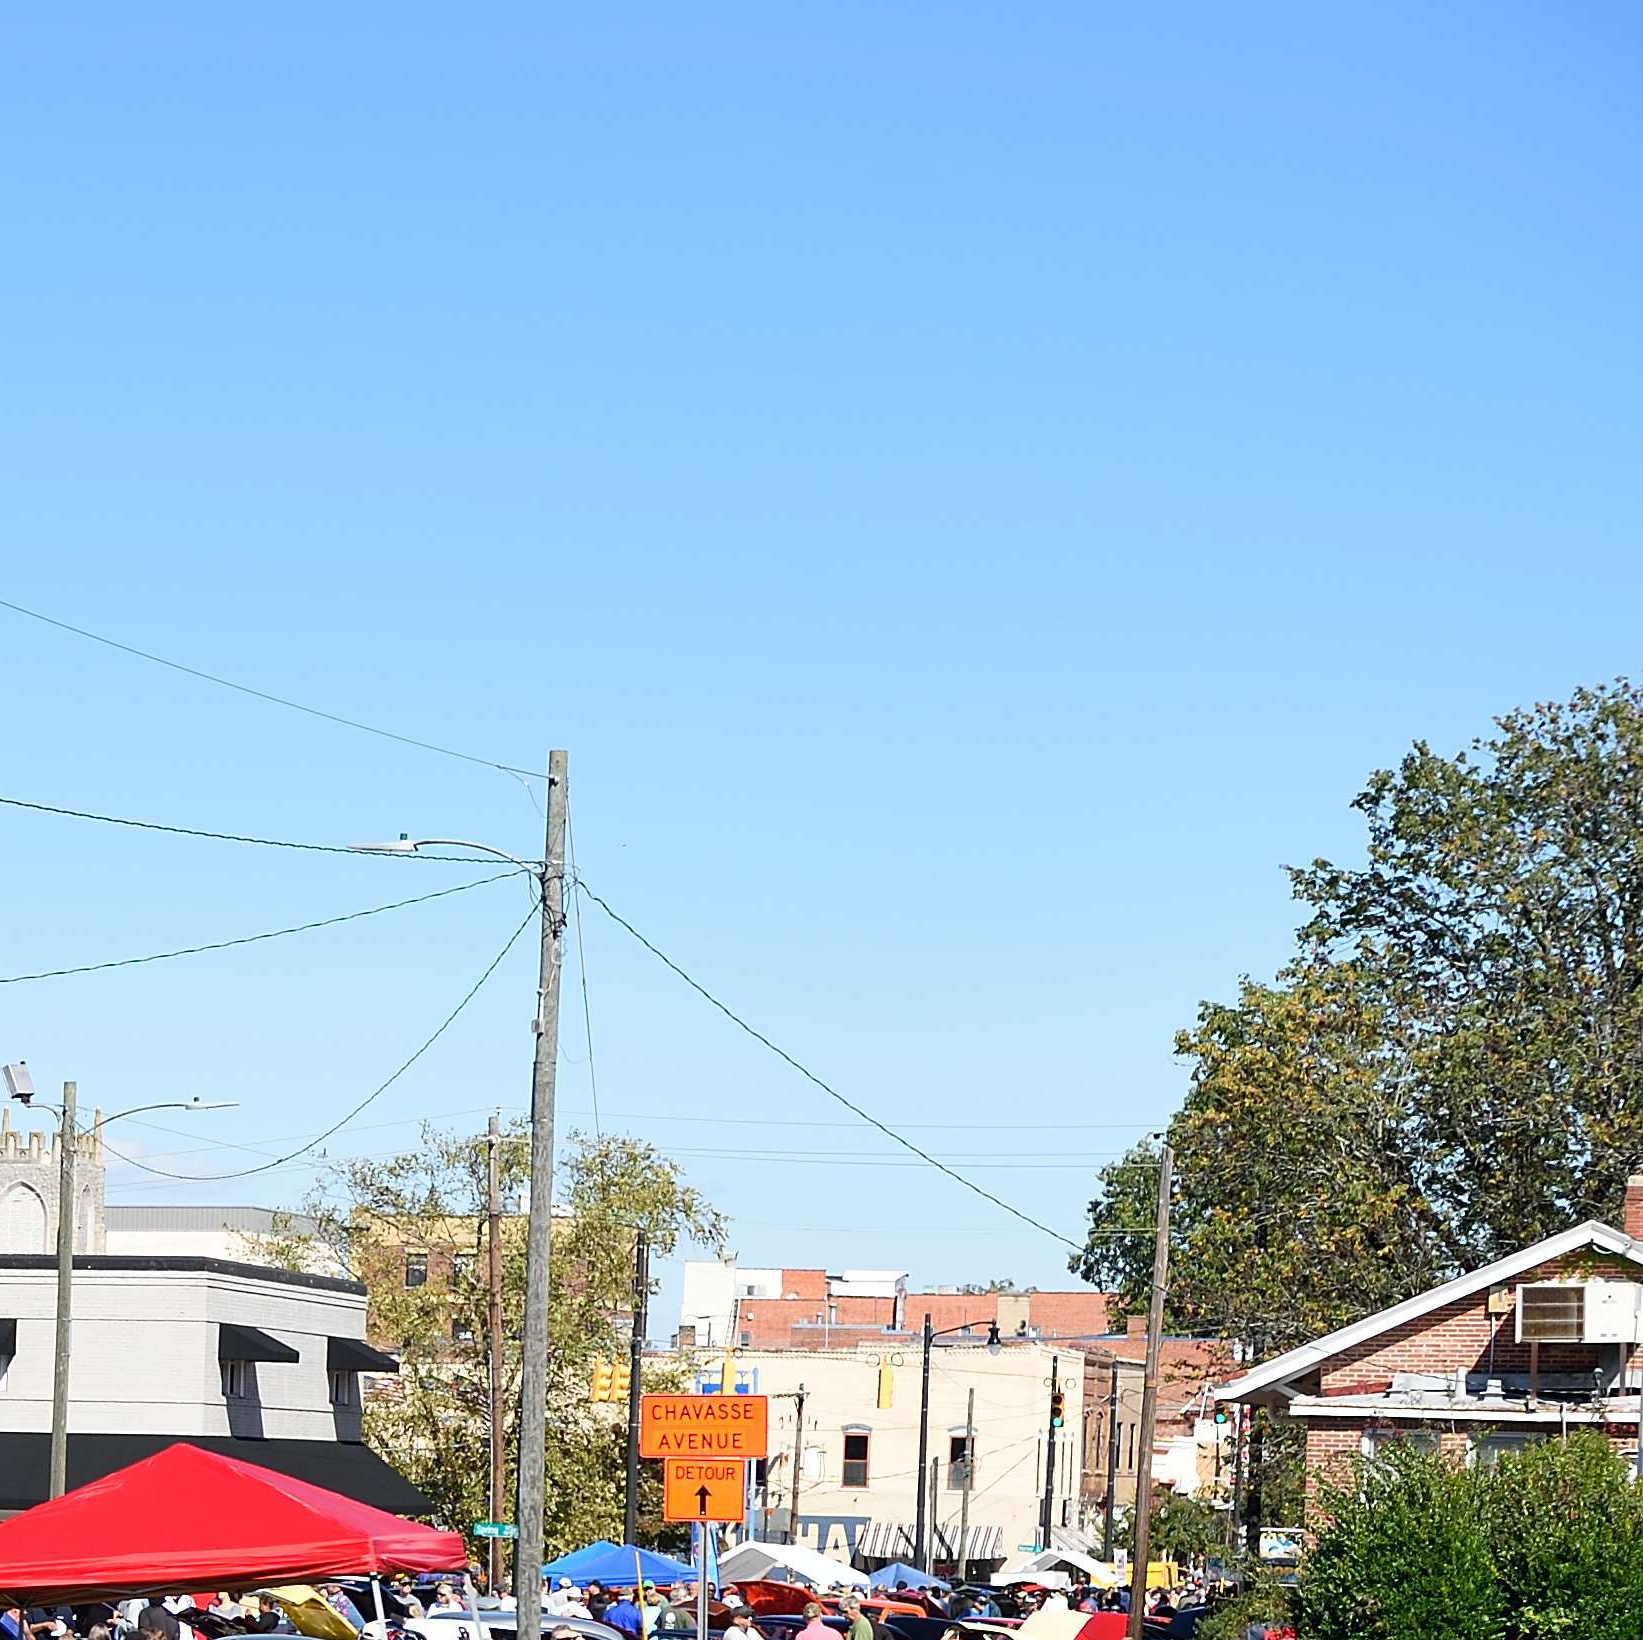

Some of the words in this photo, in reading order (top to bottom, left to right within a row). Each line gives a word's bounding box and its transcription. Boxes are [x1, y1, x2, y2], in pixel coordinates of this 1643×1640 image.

[651, 1403, 755, 1420] CHAVASSE
[658, 1433, 743, 1449] AVENUE
[675, 1465, 736, 1481] DETOUR
